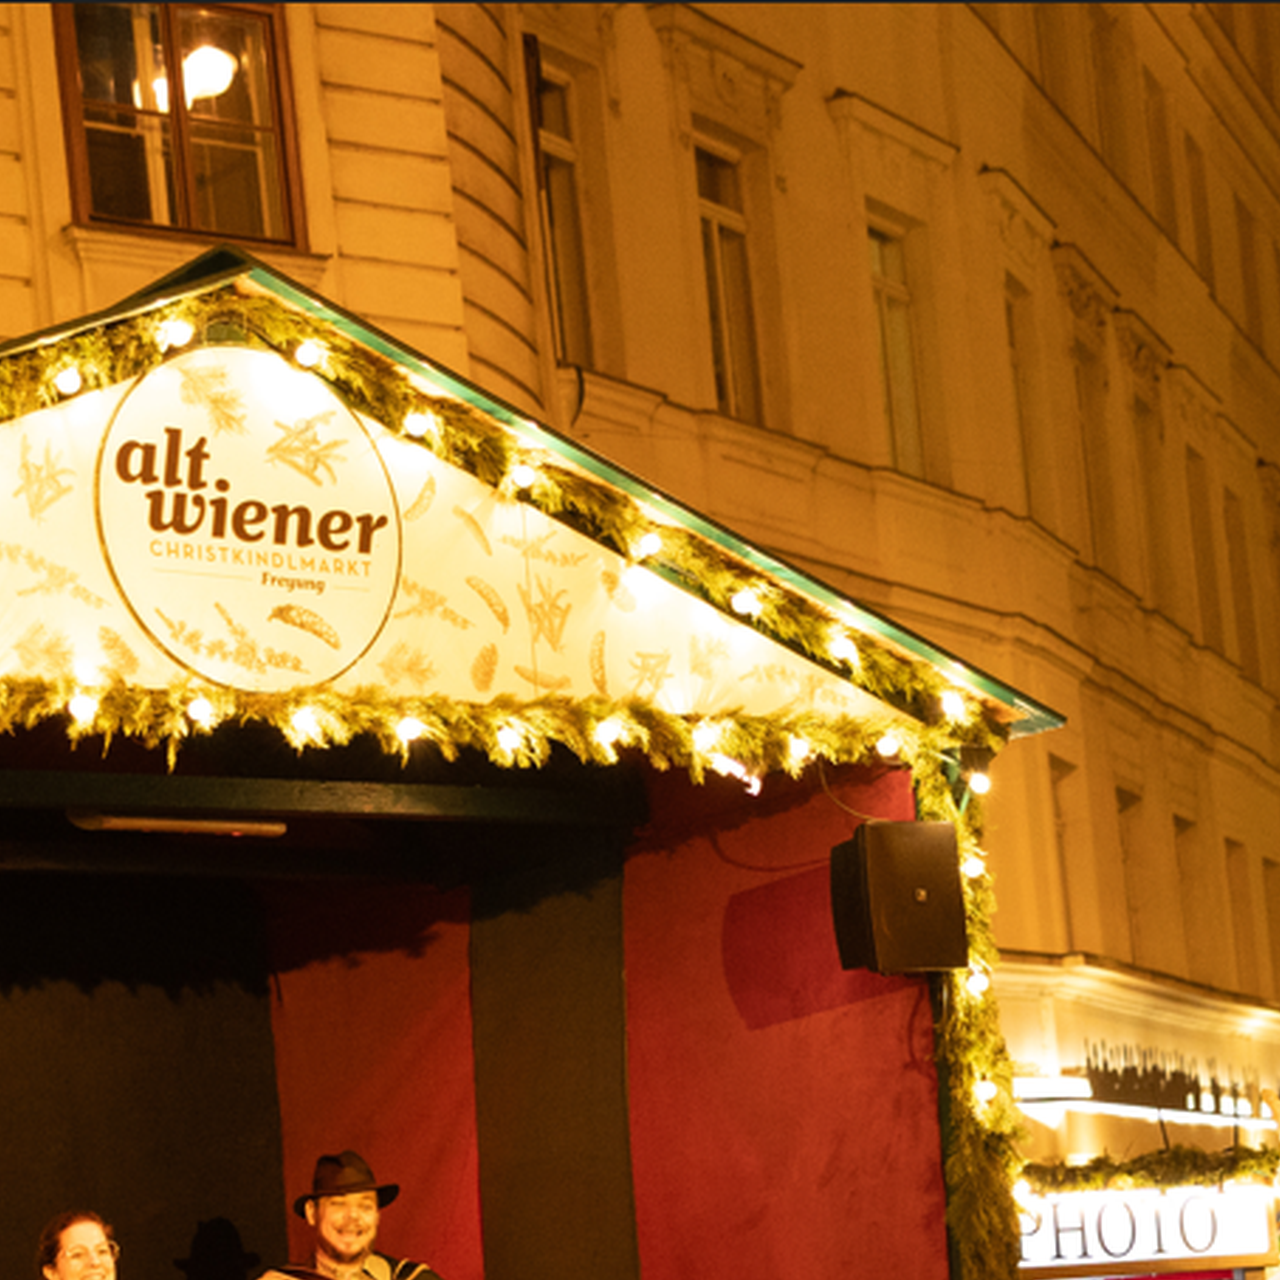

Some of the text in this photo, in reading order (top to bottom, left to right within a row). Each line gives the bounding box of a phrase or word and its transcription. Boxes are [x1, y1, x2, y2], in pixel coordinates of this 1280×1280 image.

[115, 427, 210, 491] alt
[145, 478, 388, 554] wiener
[149, 539, 372, 577] CHRISTKINDLMARKT
[261, 571, 326, 595] Freyung
